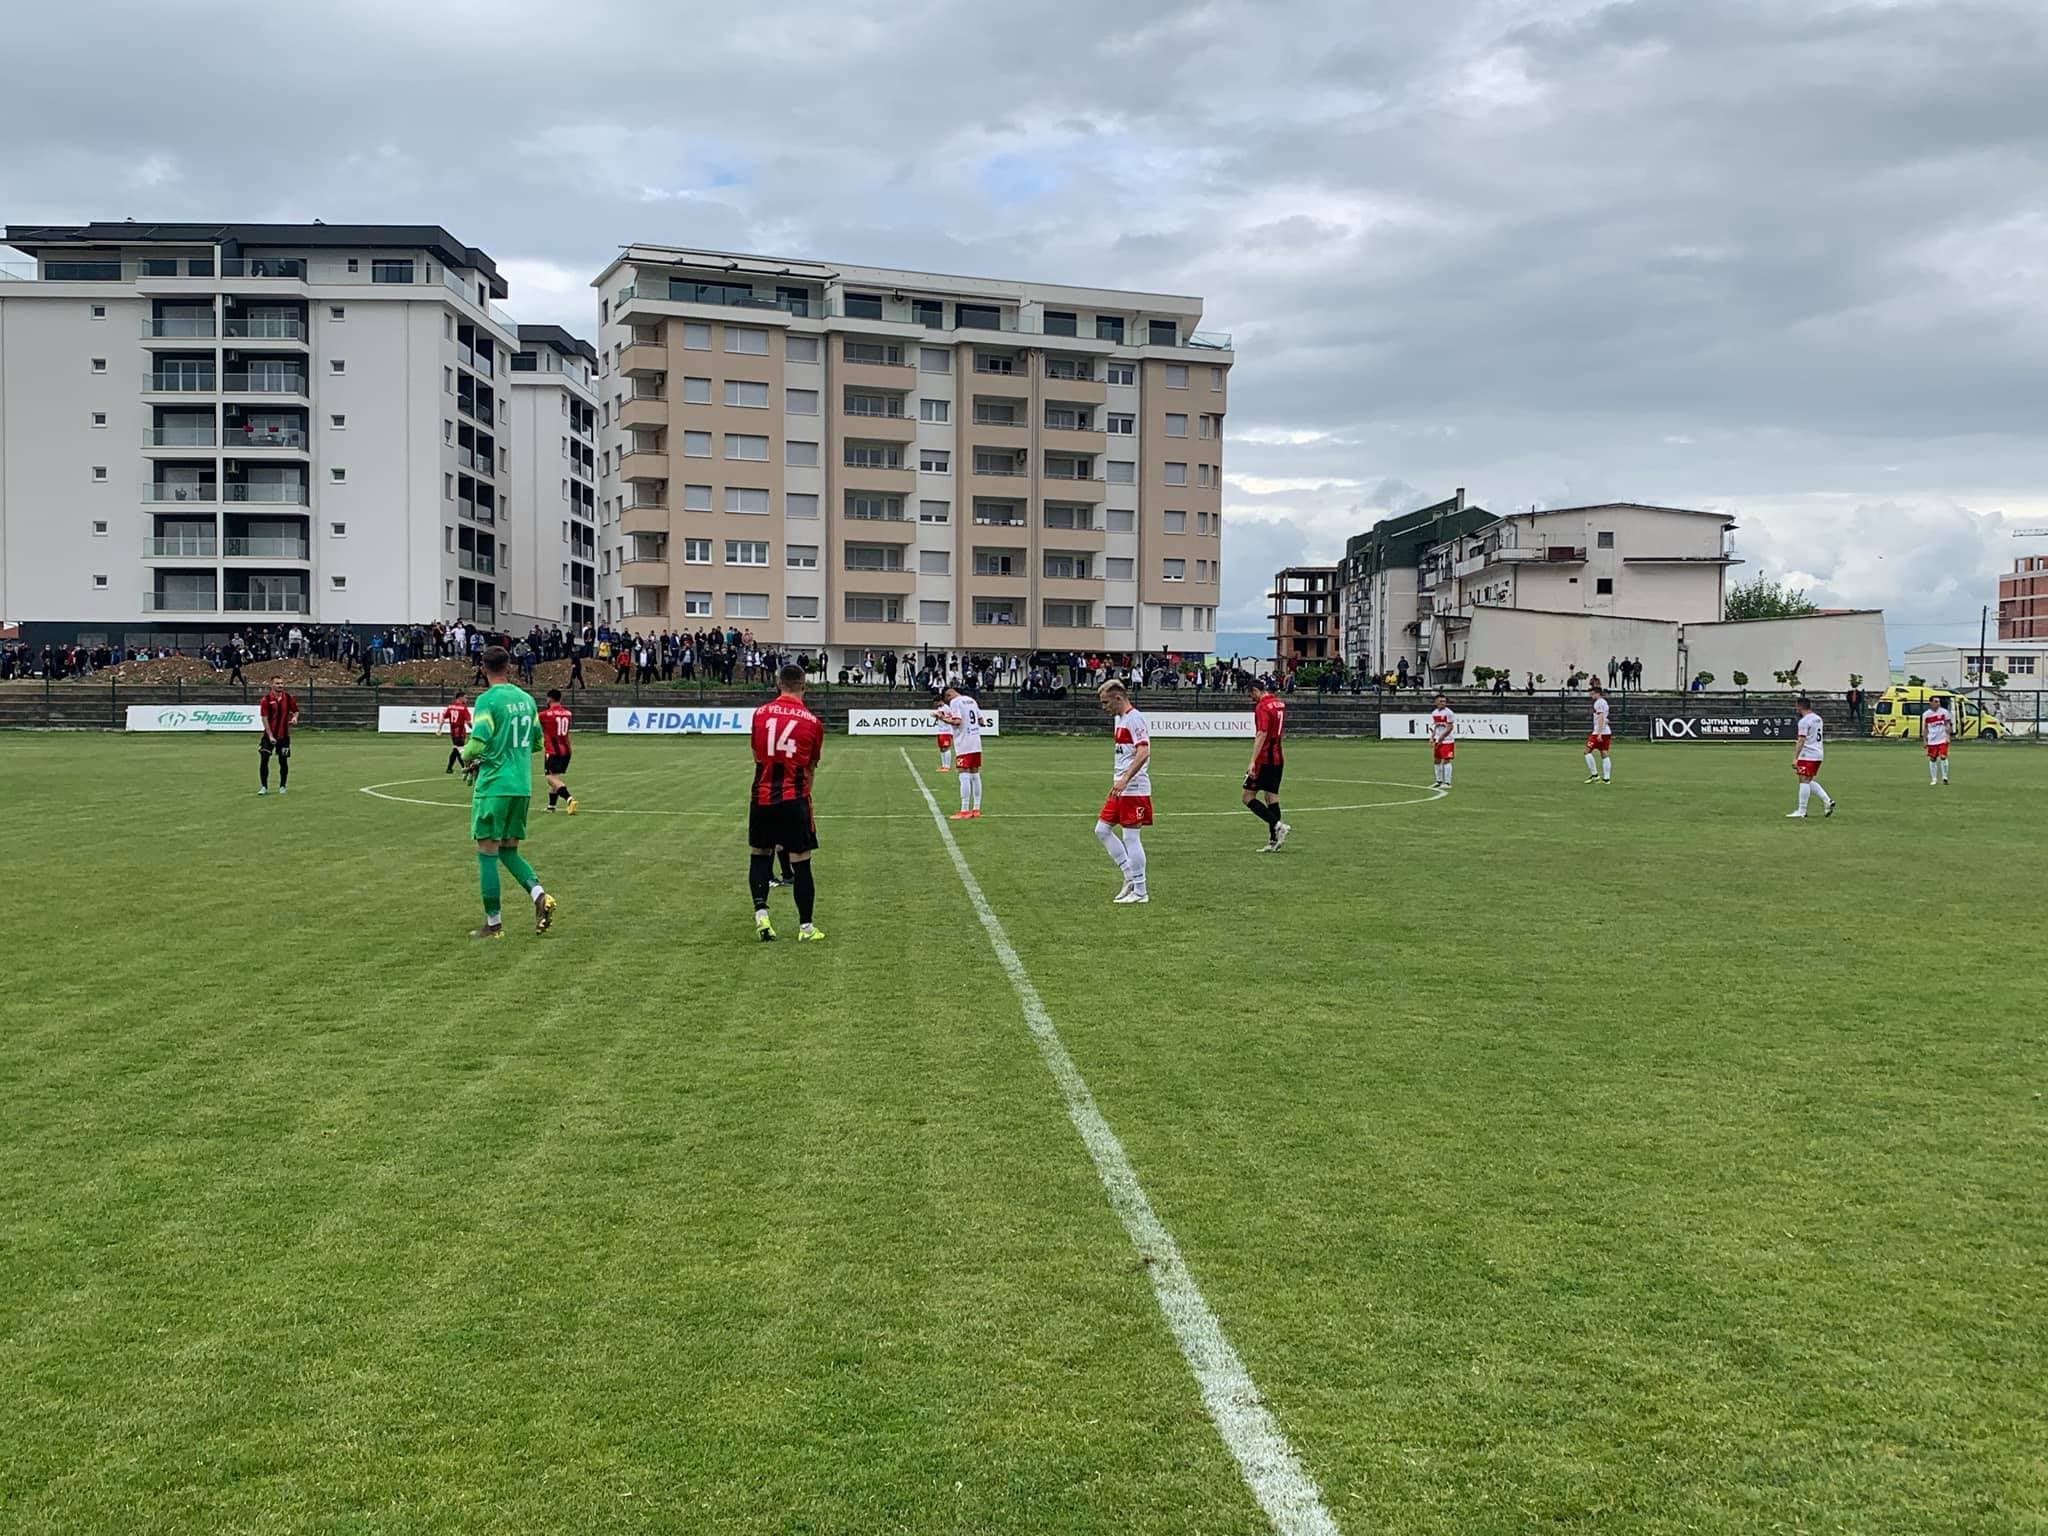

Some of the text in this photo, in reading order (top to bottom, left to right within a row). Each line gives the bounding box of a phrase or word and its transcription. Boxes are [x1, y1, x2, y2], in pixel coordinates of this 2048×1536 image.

[646, 713, 742, 729] FIDANI-L
[873, 718, 907, 728] ARDIT
[969, 710, 976, 725] 9
[1151, 720, 1252, 731] EUROPEAN CLINIC
[1277, 710, 1284, 735] 7
[511, 715, 531, 748] 12
[556, 716, 569, 736] 10
[1489, 724, 1509, 735] VG
[765, 717, 798, 759] 14
